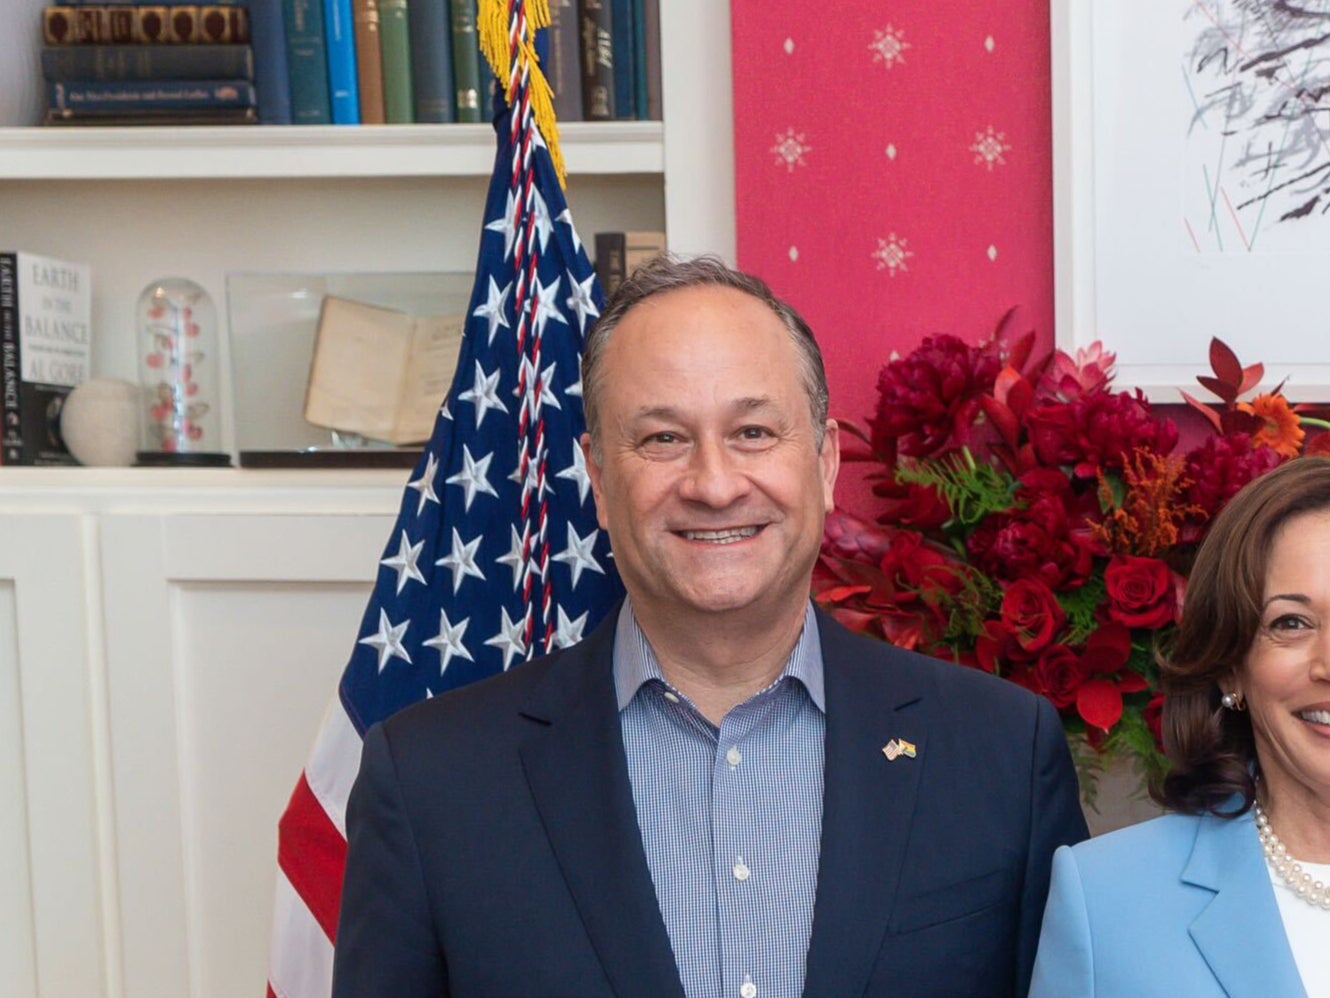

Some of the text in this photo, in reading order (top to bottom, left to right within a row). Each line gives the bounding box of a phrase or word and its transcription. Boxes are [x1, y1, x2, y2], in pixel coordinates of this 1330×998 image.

[1, 256, 13, 307] EARTH
[32, 264, 80, 292] EARTH
[25, 316, 88, 344] BALANCE
[4, 341, 17, 408] BALANCE
